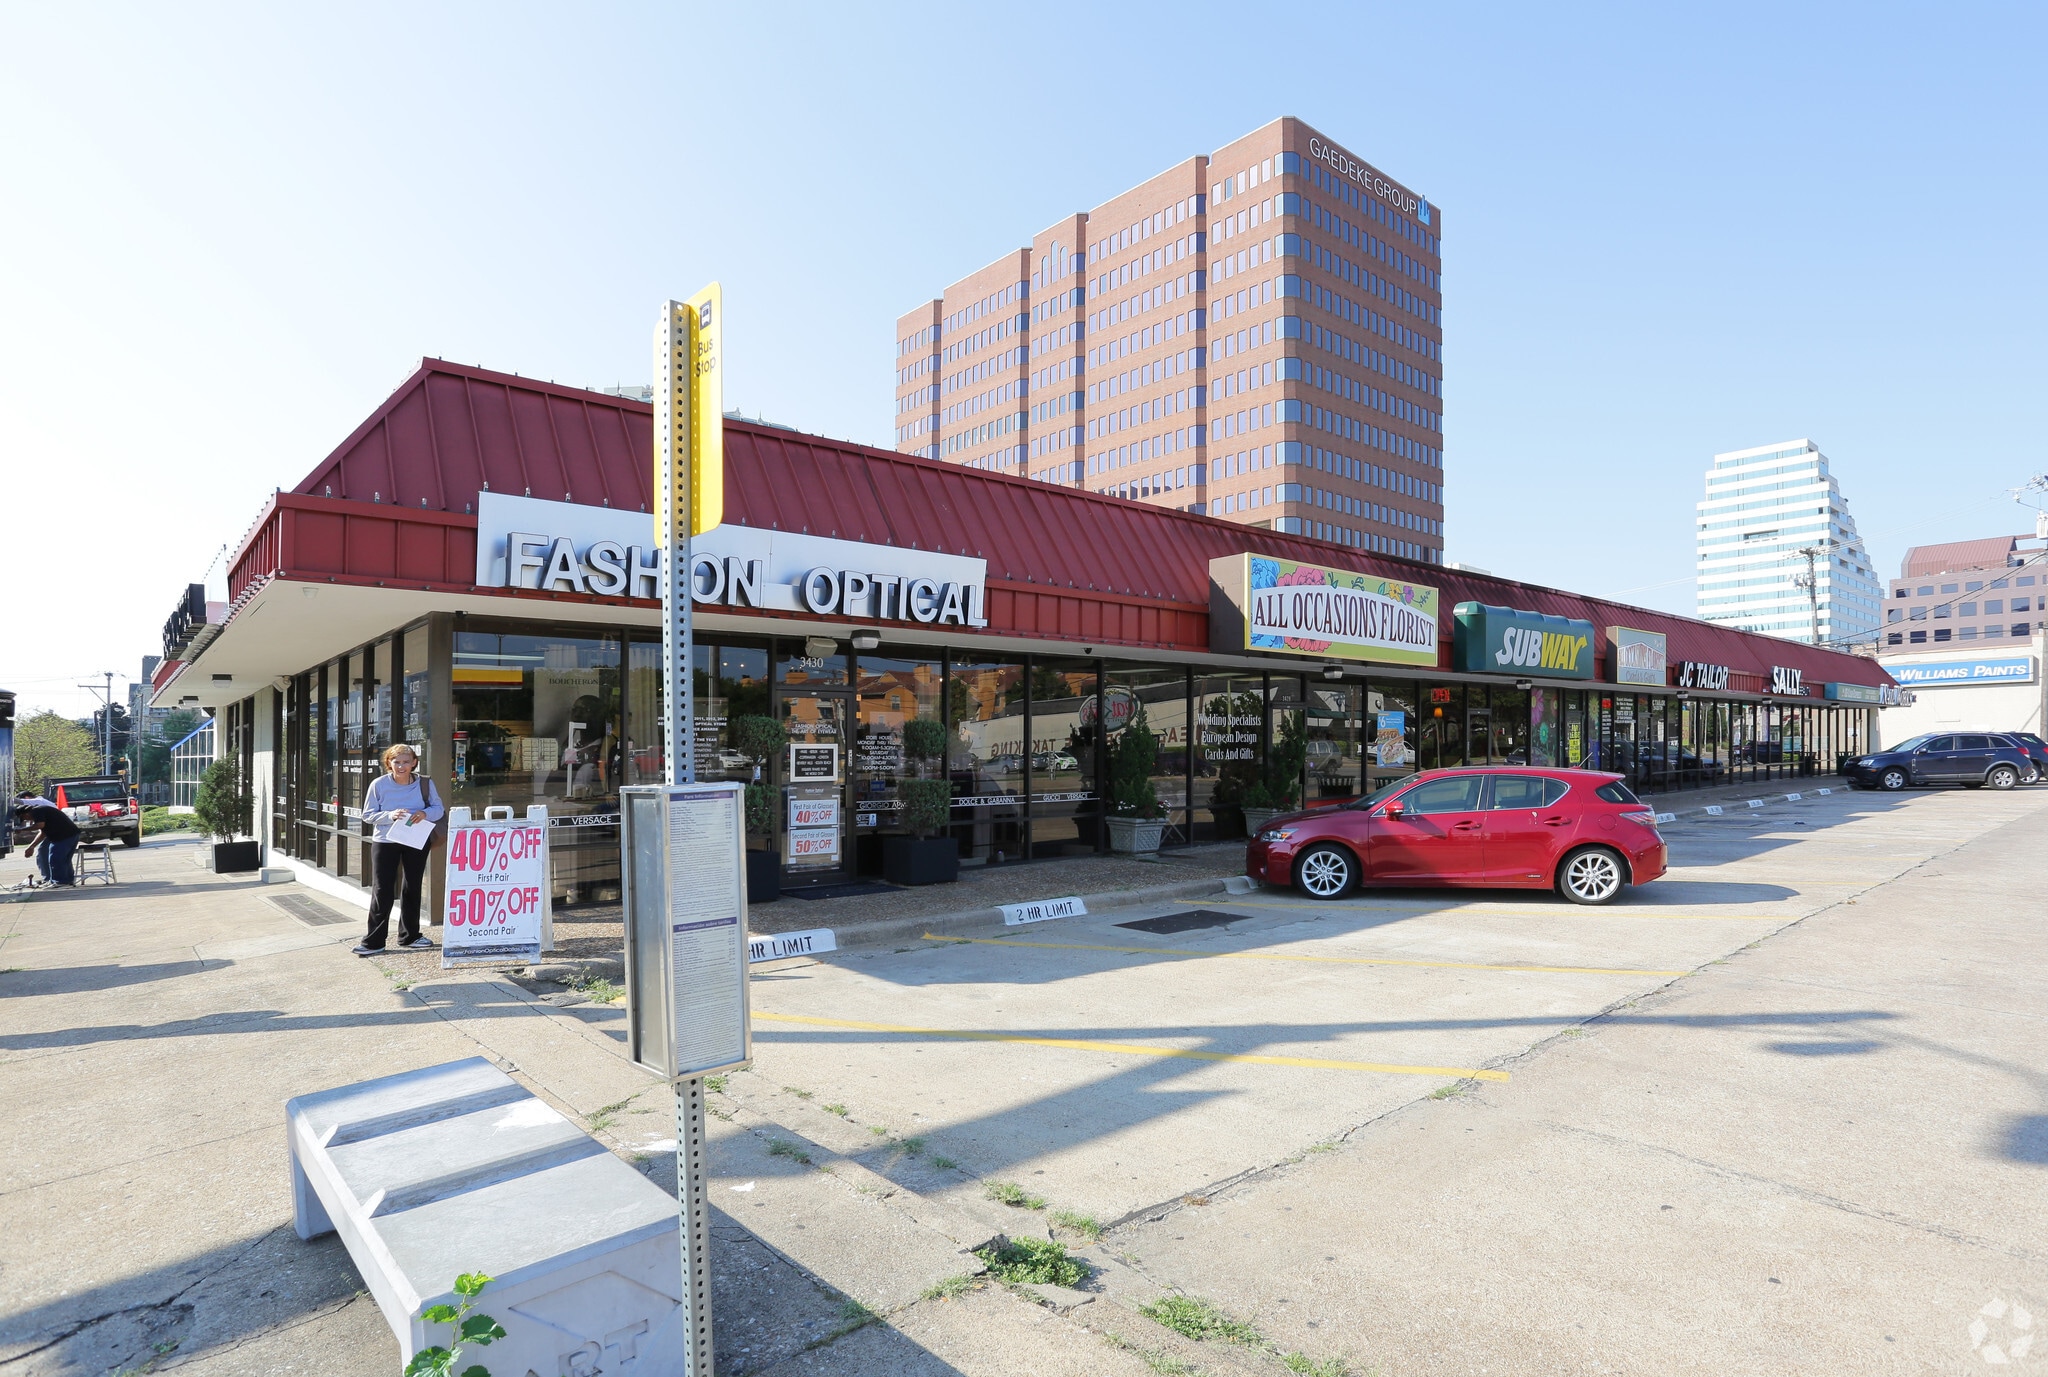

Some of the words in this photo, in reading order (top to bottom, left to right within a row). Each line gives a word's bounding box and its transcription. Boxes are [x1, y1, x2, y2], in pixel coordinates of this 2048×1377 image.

[1309, 137, 1372, 190] GAEDEKE
[1374, 178, 1417, 214] GROUP
[698, 338, 714, 357] Bus
[695, 356, 716, 378] Stop
[508, 531, 763, 607] FASHON
[802, 566, 988, 627] OPTICAL
[1253, 596, 1288, 628] ALL
[1292, 591, 1377, 639] OCCASIONS
[1380, 602, 1434, 646] FLORIST
[1495, 626, 1588, 670] SUBWAY
[800, 656, 824, 668] 3430
[1679, 660, 1694, 688] JC
[1696, 662, 1729, 690] TAILOR
[1771, 665, 1801, 695] SALLY
[1889, 667, 1968, 681] -WILLIAMS
[1974, 664, 2027, 677] PAINTS
[1198, 713, 1227, 728] Wedding
[1227, 713, 1262, 728] Specialists
[1201, 730, 1235, 745] European
[1235, 730, 1257, 745] Design
[1204, 748, 1225, 760] Cards
[1225, 748, 1239, 760] And
[1240, 747, 1254, 760] Gifts
[958, 798, 978, 806] DOLCE
[548, 818, 560, 826] DI
[571, 815, 612, 826] VERSACE
[795, 810, 819, 824] 40%
[818, 810, 833, 820] OFF
[450, 828, 509, 872] 40%
[509, 827, 542, 860] OFF
[795, 840, 819, 854] 50%
[818, 839, 832, 849] OFF
[477, 873, 493, 882] First
[494, 872, 510, 882] Pair
[449, 888, 505, 926] 50%
[507, 886, 539, 915] OFF
[1016, 908, 1024, 921] 2
[1026, 906, 1042, 920] HR
[1045, 902, 1075, 918] LIMIT
[468, 925, 499, 937] Second
[501, 925, 517, 936] Pair
[773, 936, 813, 956] LIMIT
